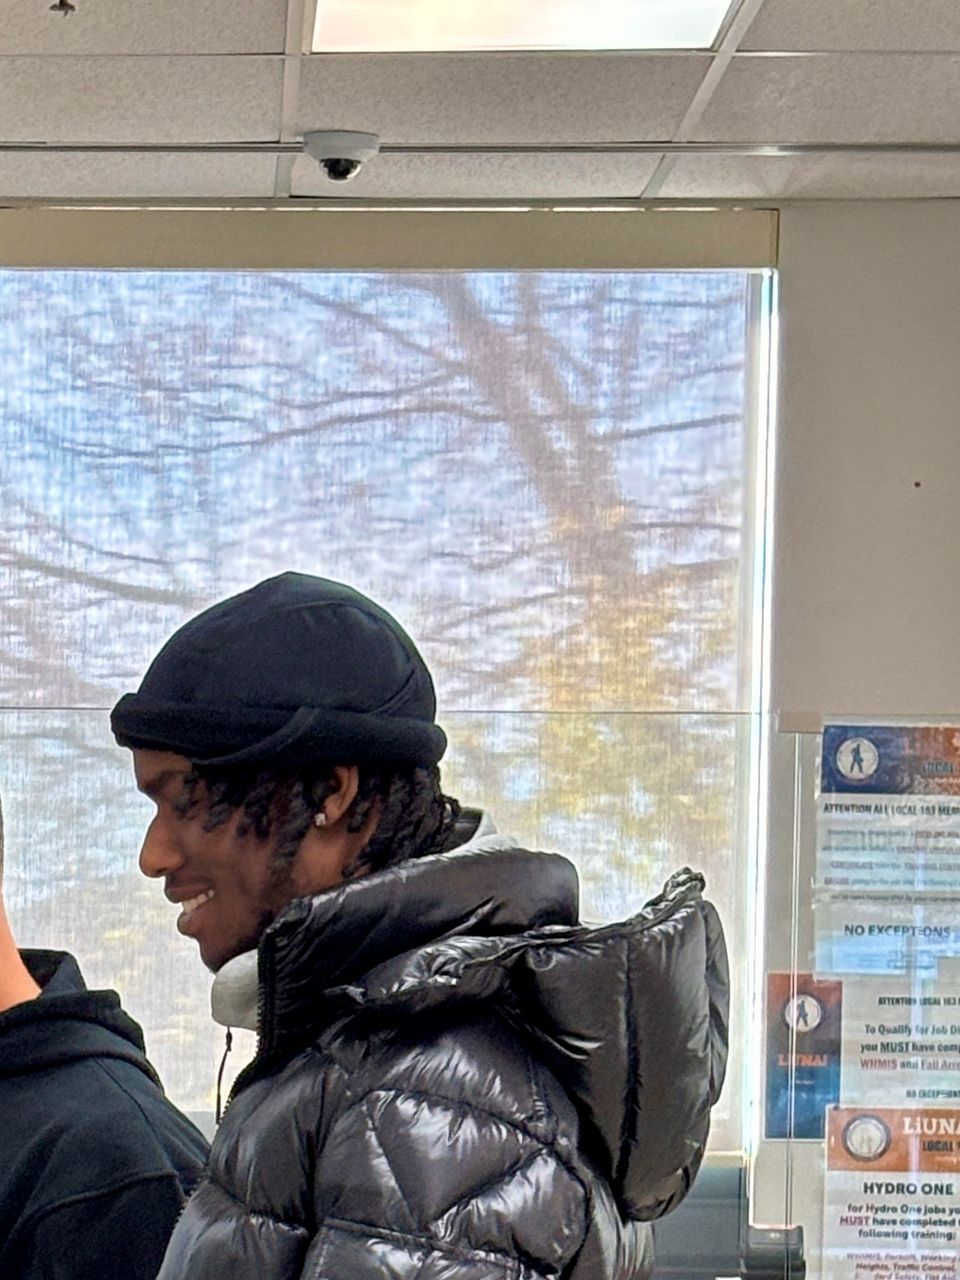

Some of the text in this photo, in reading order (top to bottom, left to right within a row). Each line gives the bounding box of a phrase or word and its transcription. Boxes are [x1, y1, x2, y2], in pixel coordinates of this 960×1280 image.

[823, 803, 872, 814] ATTENTION
[844, 924, 865, 936] NO
[864, 1024, 876, 1035] To
[878, 1024, 912, 1037] Qualify
[915, 1024, 929, 1035] for
[930, 1024, 948, 1036] Job
[860, 1043, 878, 1054] you
[880, 1041, 910, 1053] MUST
[912, 1042, 936, 1052] have
[920, 1059, 940, 1070] Fall
[863, 1182, 954, 1196] HYDRO ONE
[847, 1203, 863, 1213] for
[866, 1203, 898, 1215] Hydro
[900, 1203, 922, 1215] One
[923, 1204, 947, 1216] jobs
[839, 1215, 956, 1228] MUST have completed
[858, 1228, 909, 1240] following
